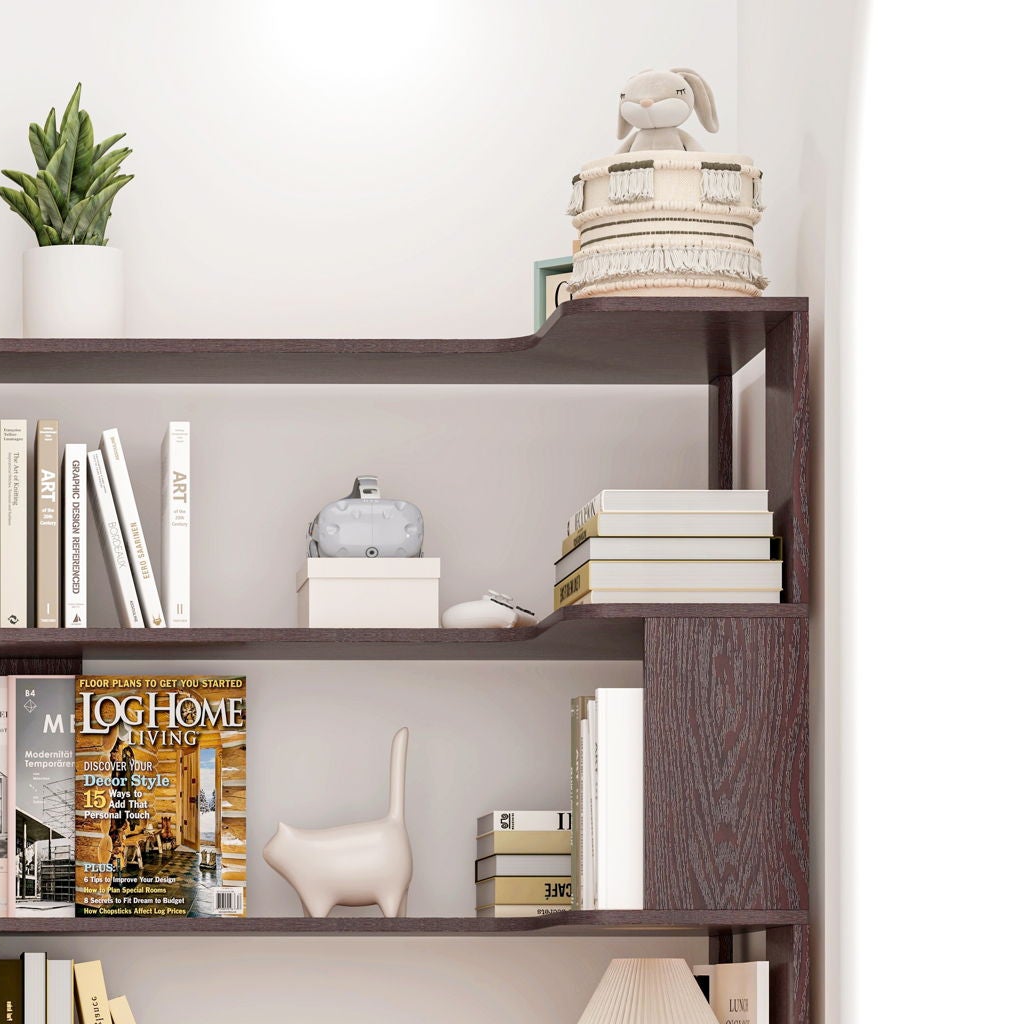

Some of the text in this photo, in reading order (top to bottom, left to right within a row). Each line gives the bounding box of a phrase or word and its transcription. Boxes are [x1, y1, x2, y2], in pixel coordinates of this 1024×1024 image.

[41, 469, 55, 502] ART
[173, 471, 187, 503] ART
[72, 460, 80, 594] GRAPHIC DESIGN REFERENCED
[79, 679, 242, 688] FLOOR PLANS TO GET YOU STARTED
[127, 731, 197, 746] LIVING
[84, 762, 152, 771] DISCOVER YOUR
[84, 774, 170, 790] Decor Style
[83, 790, 106, 808] 15
[109, 789, 142, 799] Ways to
[109, 800, 147, 808] Add That
[84, 810, 150, 819] Personal Touch
[84, 864, 115, 873] PLUS:
[98, 907, 132, 916] Chopsticks
[154, 907, 165, 916] Log
